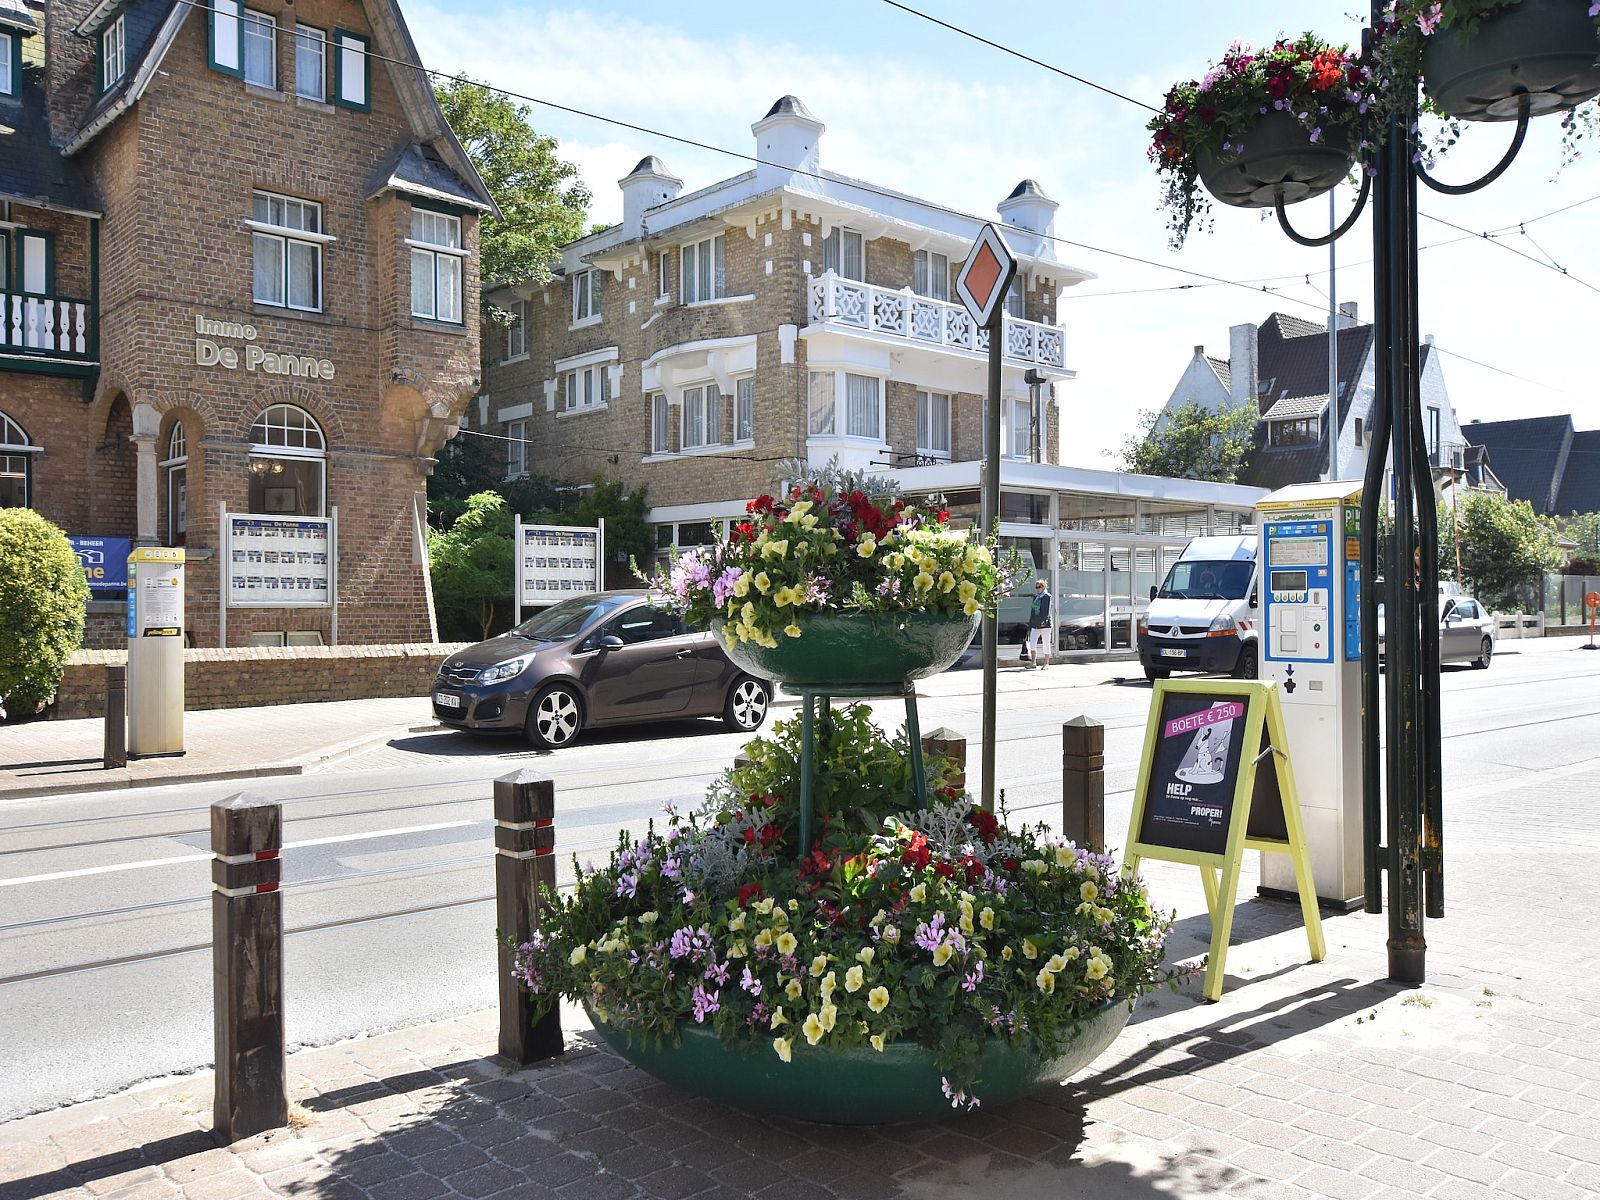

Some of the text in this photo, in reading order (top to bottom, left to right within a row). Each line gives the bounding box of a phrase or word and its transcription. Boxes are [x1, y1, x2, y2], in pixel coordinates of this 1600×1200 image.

[196, 315, 257, 340] Immo
[196, 338, 335, 380] De Panne
[83, 567, 104, 578] ne
[1172, 705, 1235, 732] BOETE € 250
[1167, 783, 1192, 796] HELP
[1191, 807, 1223, 818] PROPER!
